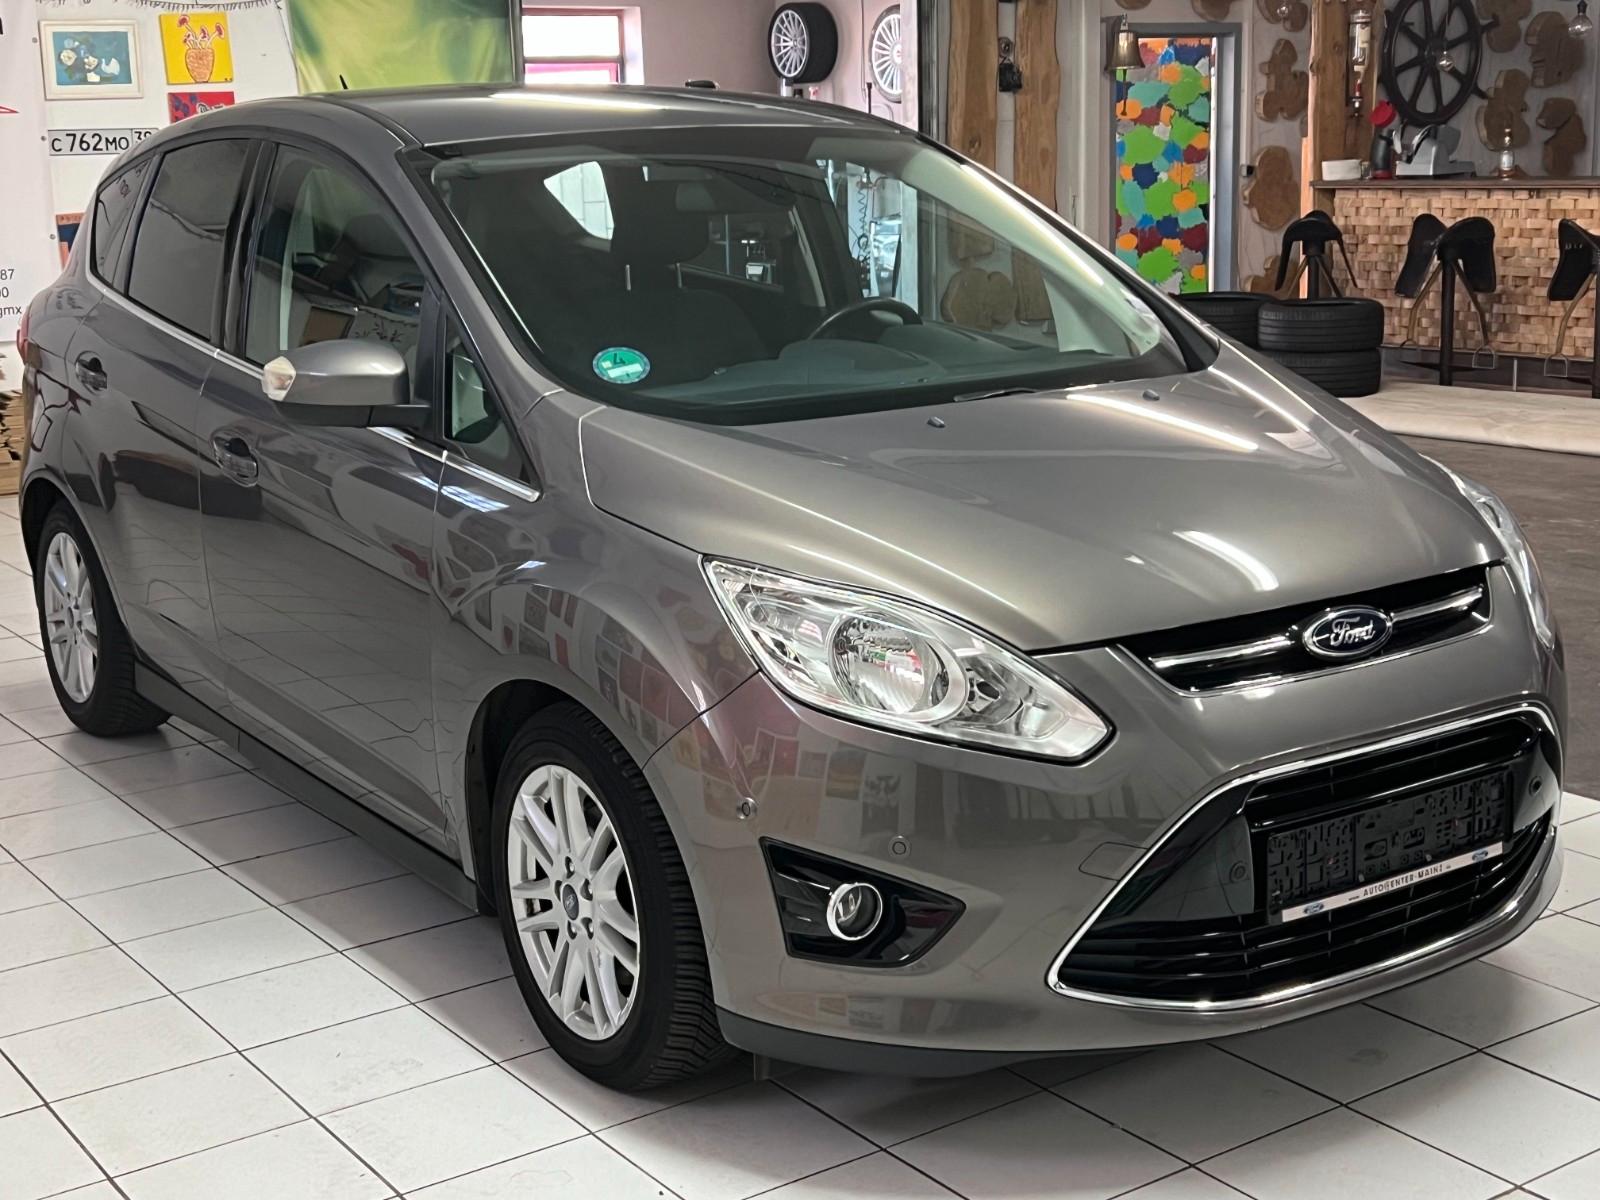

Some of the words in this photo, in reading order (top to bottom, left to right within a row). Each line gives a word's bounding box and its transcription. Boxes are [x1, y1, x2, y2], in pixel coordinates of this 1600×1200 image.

[0, 268, 15, 280] 87
[0, 286, 9, 298] 0
[0, 305, 22, 318] mx
[1330, 616, 1376, 647] Ford
